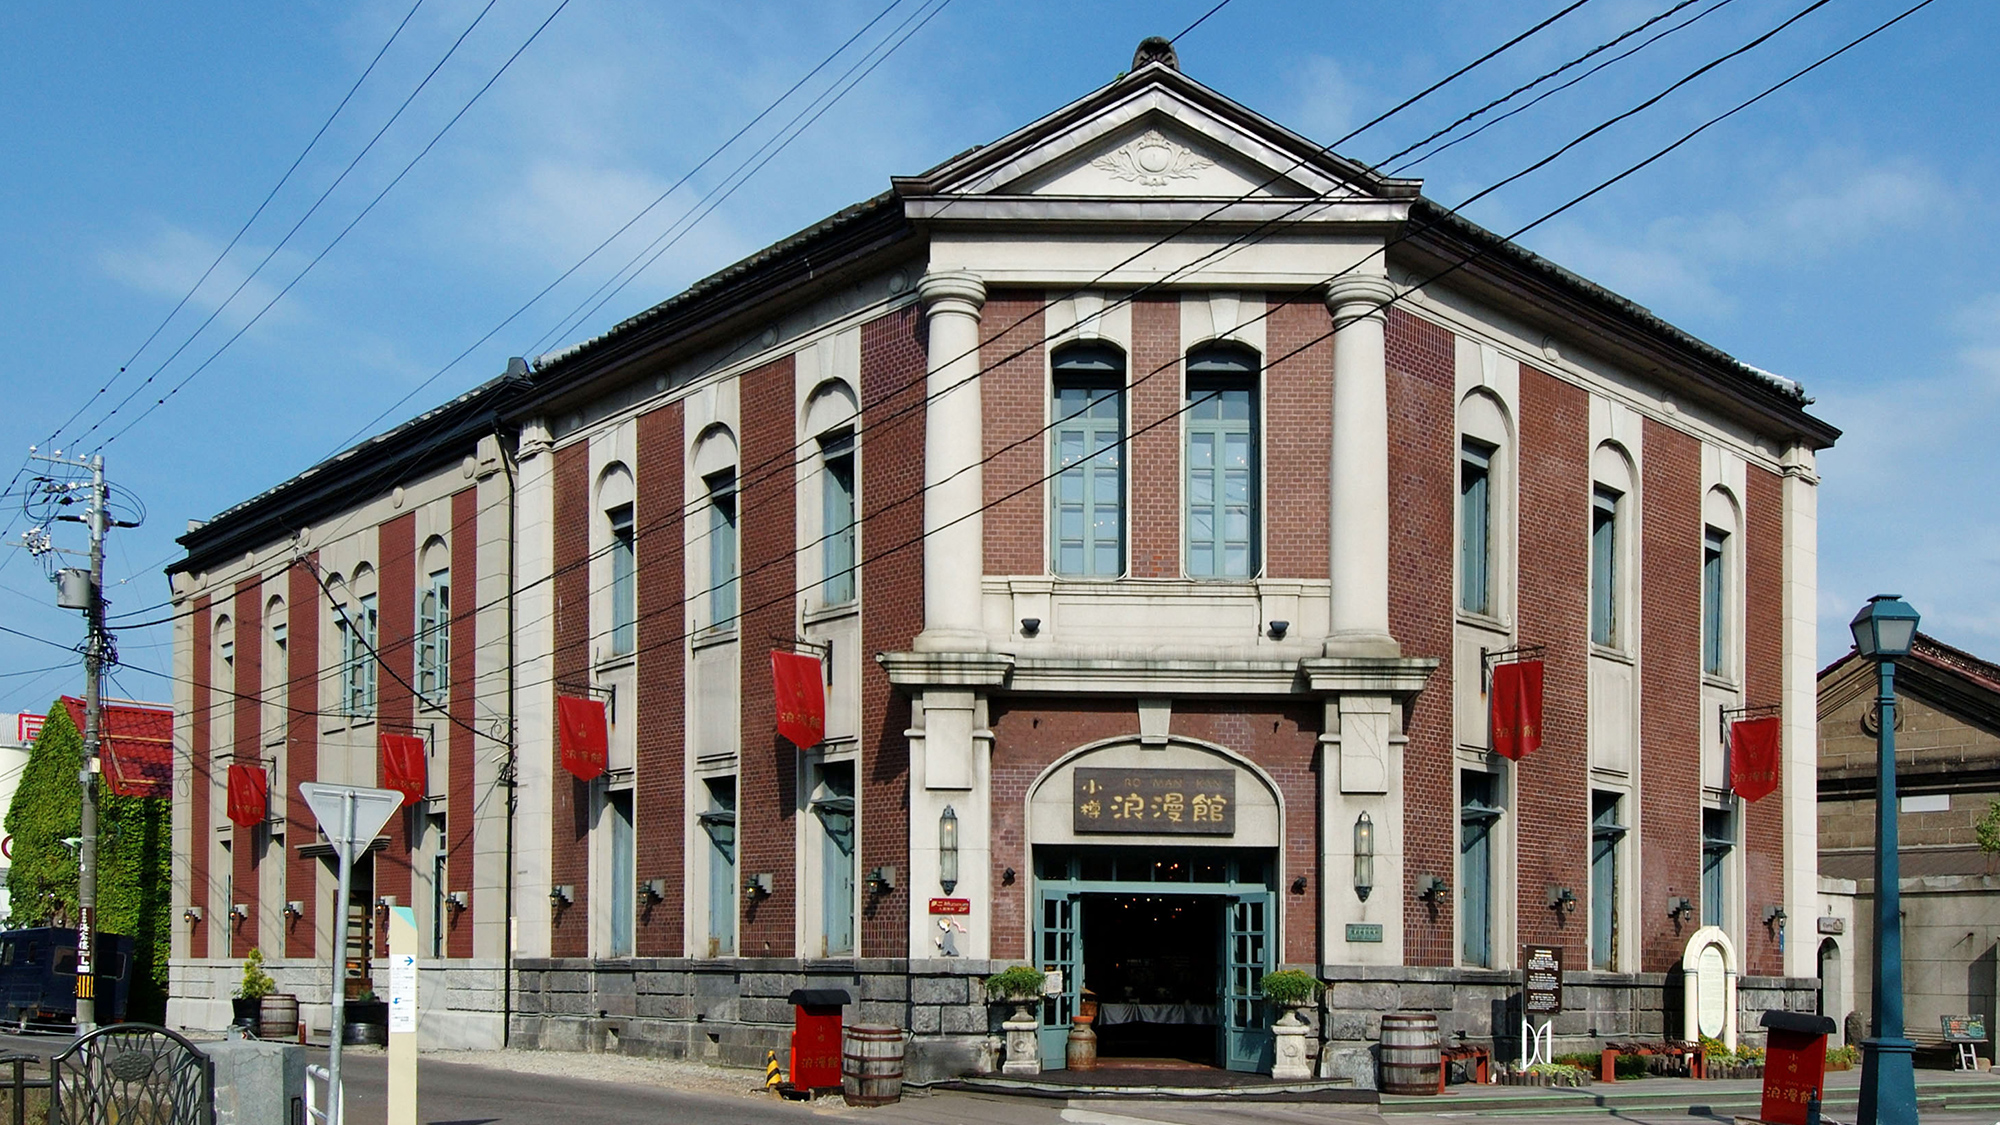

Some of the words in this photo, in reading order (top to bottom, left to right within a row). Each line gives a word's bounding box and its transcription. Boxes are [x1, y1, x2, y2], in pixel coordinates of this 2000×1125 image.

[1124, 778, 1142, 788] RO
[1152, 778, 1183, 788] MAN
[1080, 779, 1103, 819] 小樽
[1110, 792, 1228, 823] 浪漫館
